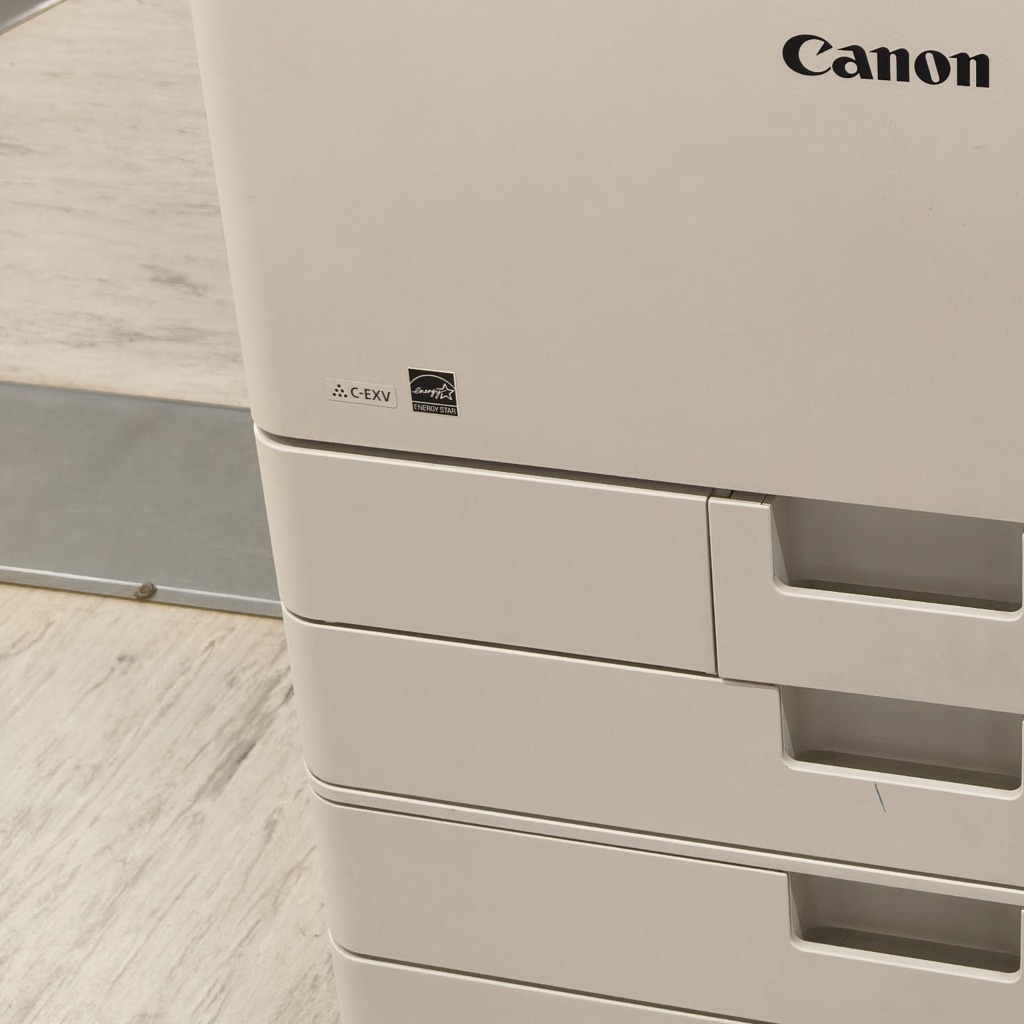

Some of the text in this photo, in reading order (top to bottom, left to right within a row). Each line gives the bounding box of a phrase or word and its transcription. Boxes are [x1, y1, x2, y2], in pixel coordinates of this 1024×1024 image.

[782, 34, 990, 88] Canon
[350, 387, 391, 402] C-EXV
[413, 403, 457, 415] ENERGY STAR
